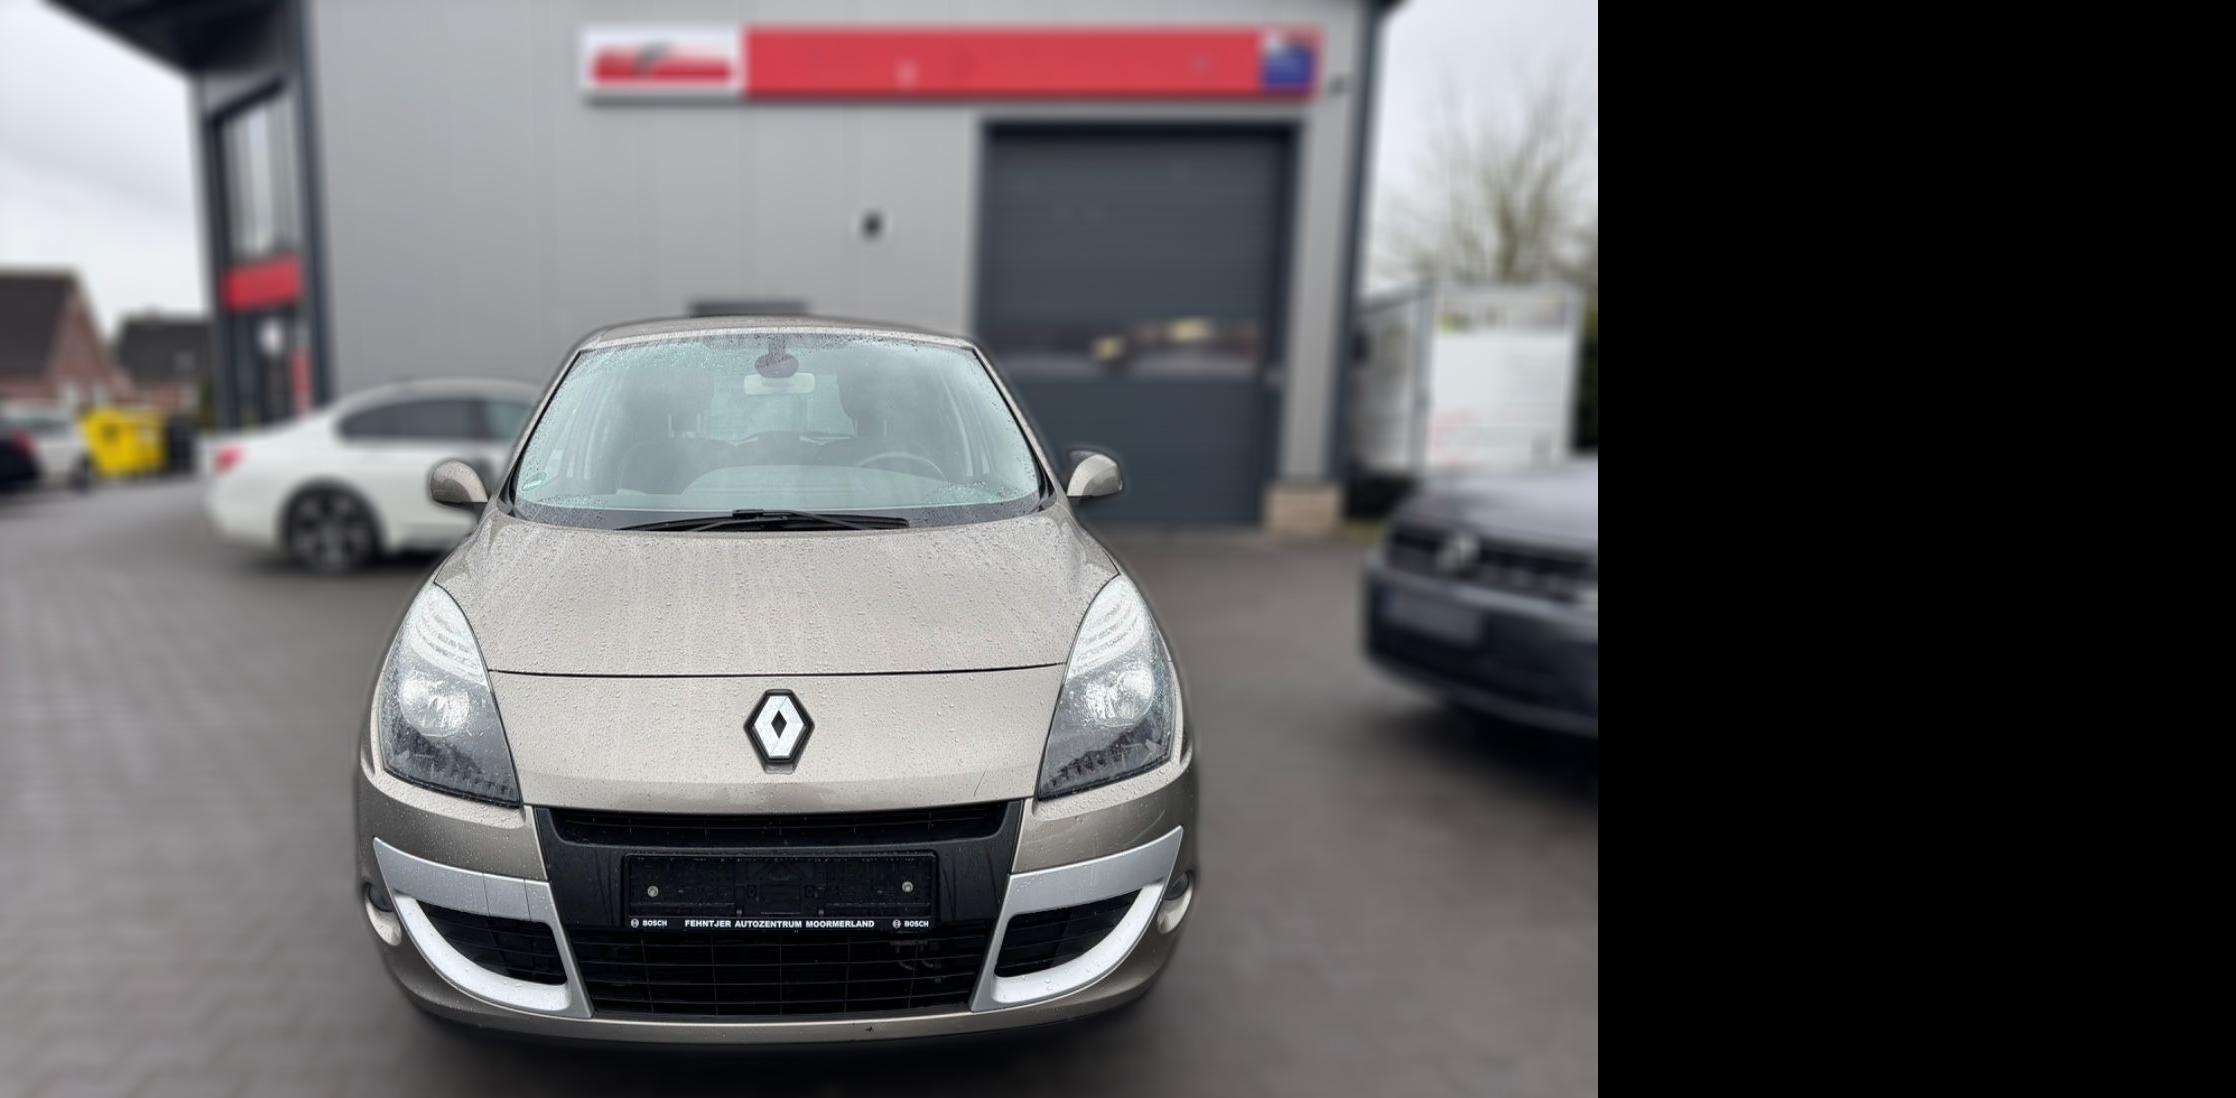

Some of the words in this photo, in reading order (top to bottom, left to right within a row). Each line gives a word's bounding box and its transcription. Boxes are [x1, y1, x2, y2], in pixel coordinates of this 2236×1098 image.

[641, 919, 668, 928] BOSCH
[684, 919, 732, 928] FEHNTJER
[734, 919, 803, 929] AUTOZENTRUM
[805, 919, 876, 929] MOORMERLAND
[903, 919, 930, 928] BOSCH
